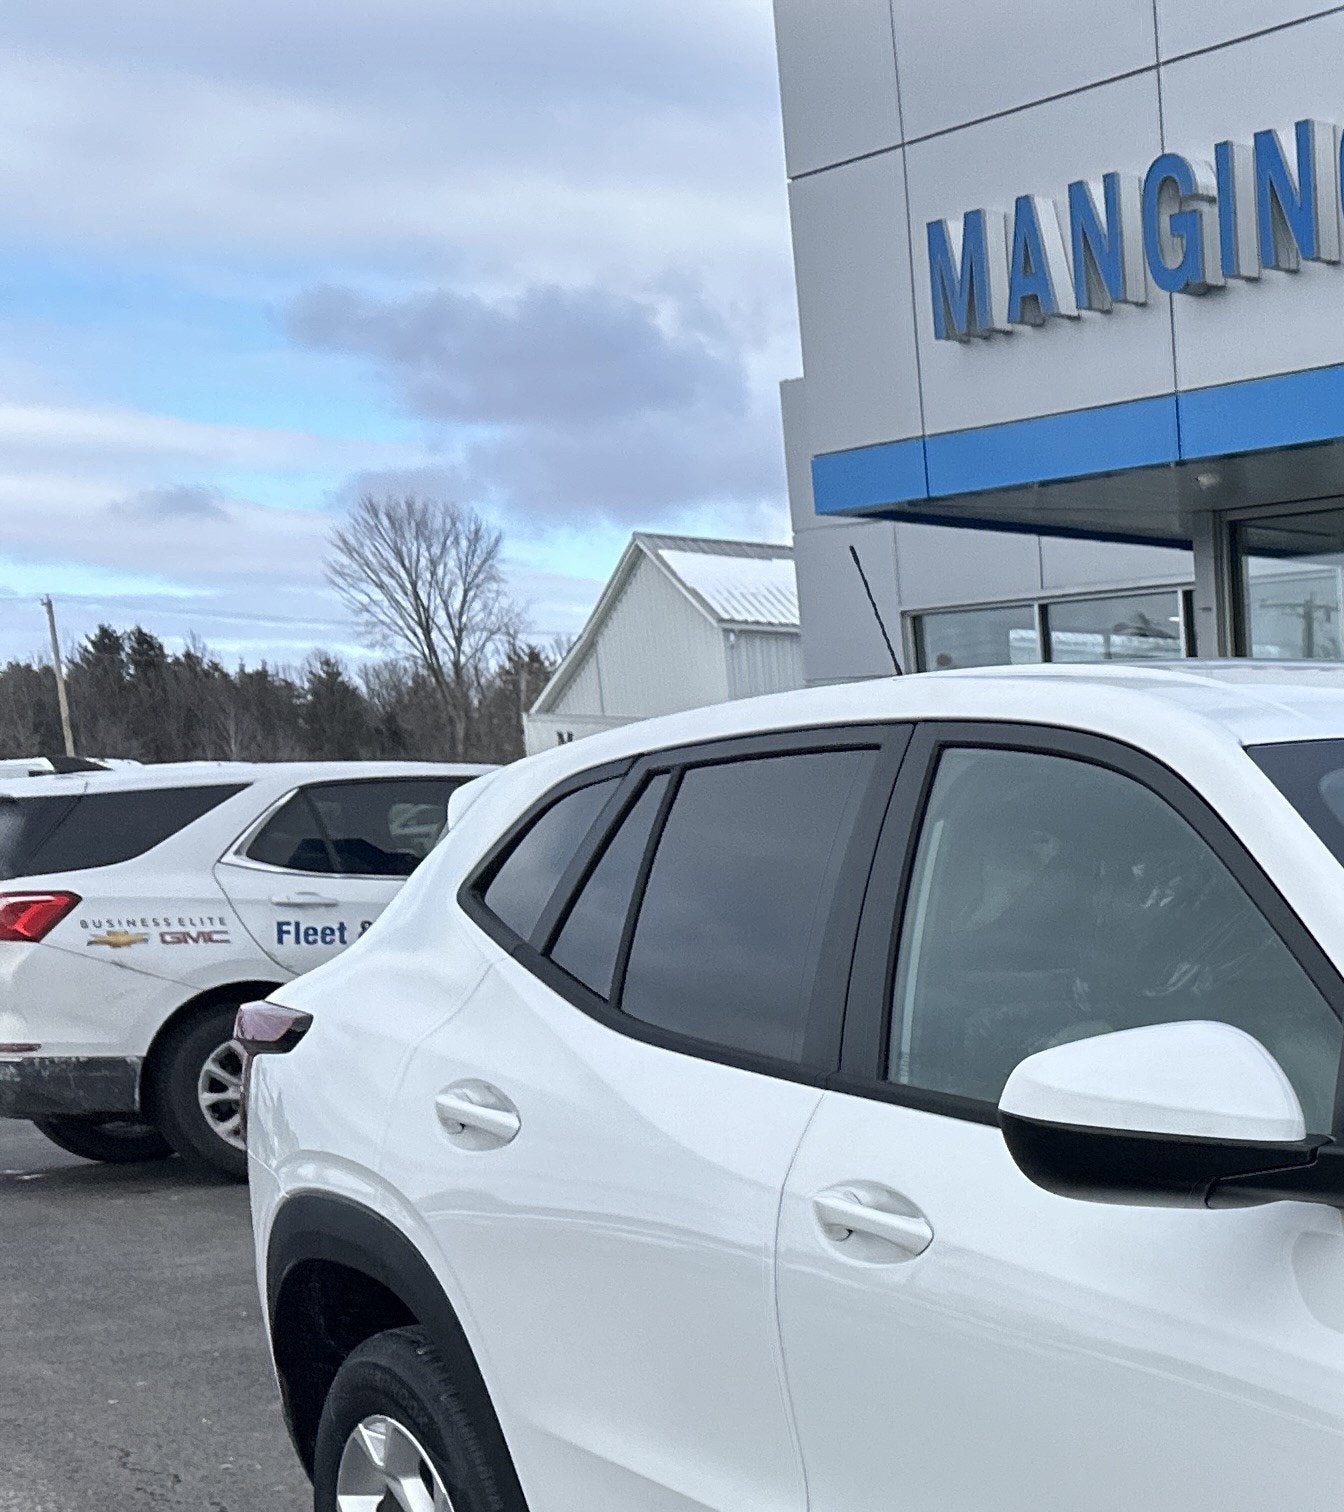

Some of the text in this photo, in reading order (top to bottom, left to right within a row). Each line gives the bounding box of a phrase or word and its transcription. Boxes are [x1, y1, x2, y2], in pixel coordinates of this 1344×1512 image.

[80, 916, 229, 929] BUSINESS ELITE
[159, 930, 231, 944] GMC
[276, 920, 348, 945] Fleet
